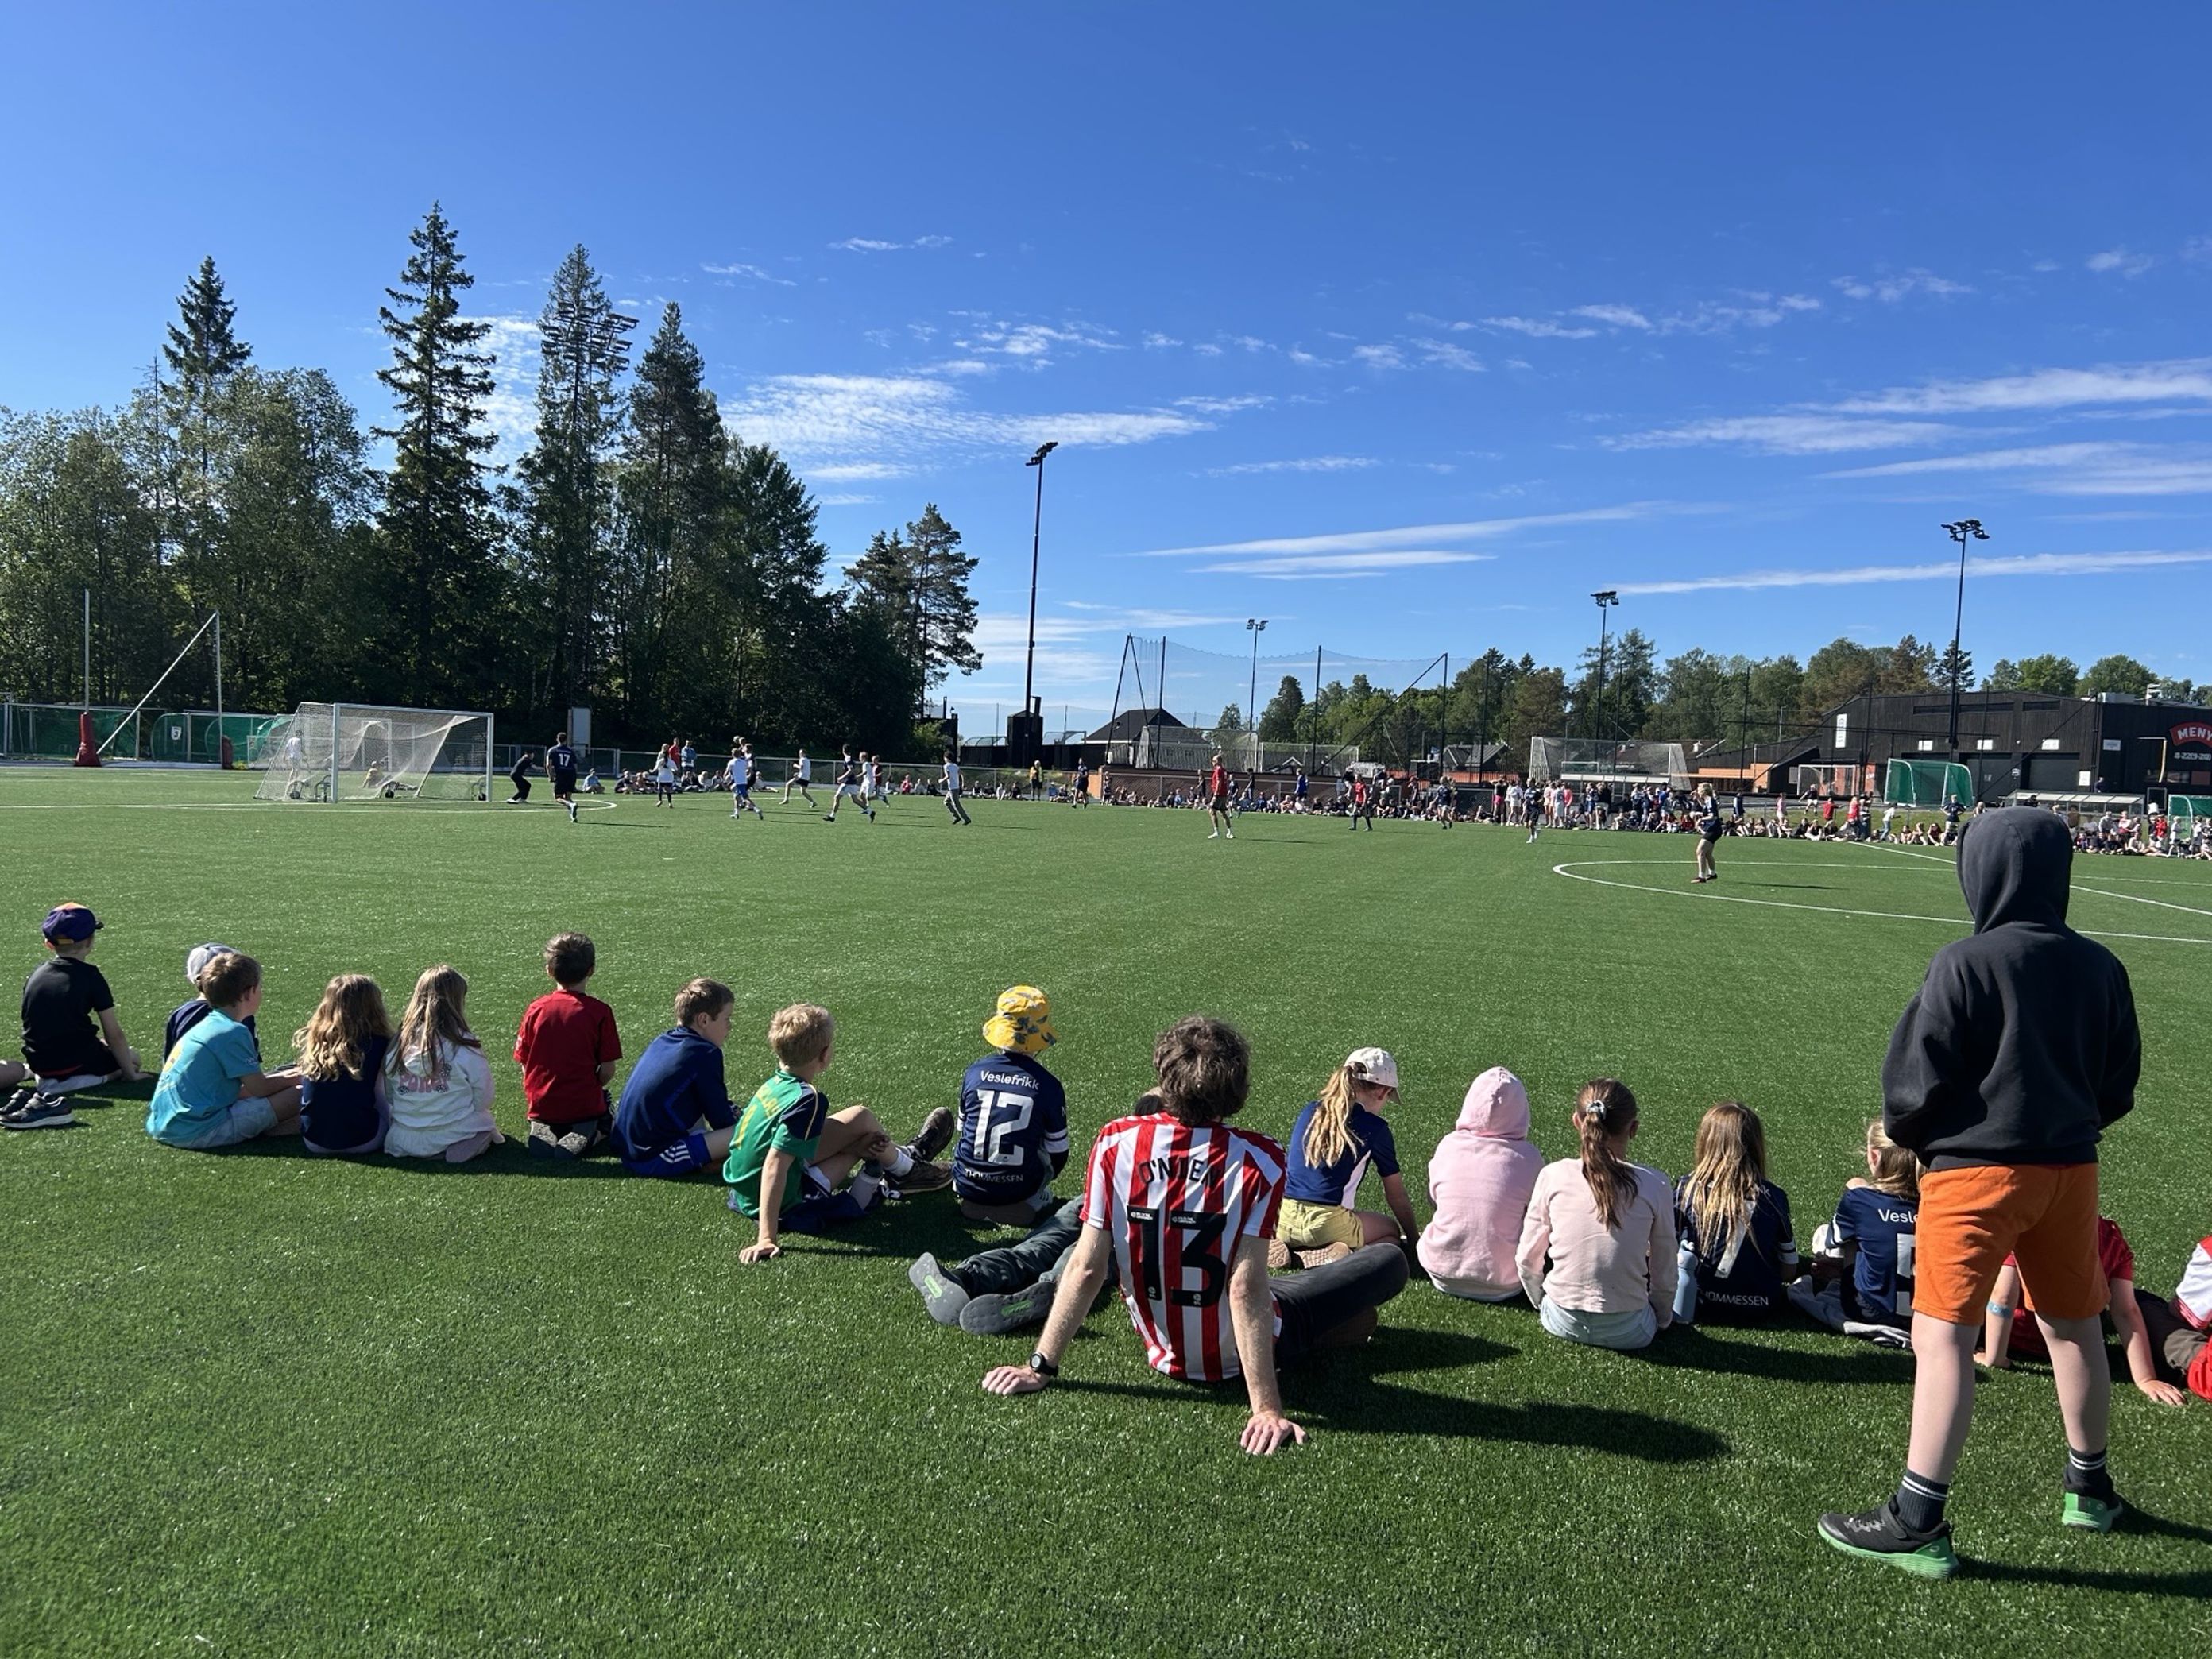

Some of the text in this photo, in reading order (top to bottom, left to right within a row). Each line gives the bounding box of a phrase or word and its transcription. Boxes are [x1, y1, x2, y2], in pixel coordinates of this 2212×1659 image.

[559, 753, 570, 767] 17
[980, 1069, 1040, 1090] Veslefrikk
[973, 1089, 1034, 1166] 12
[1126, 1205, 1228, 1307] 13
